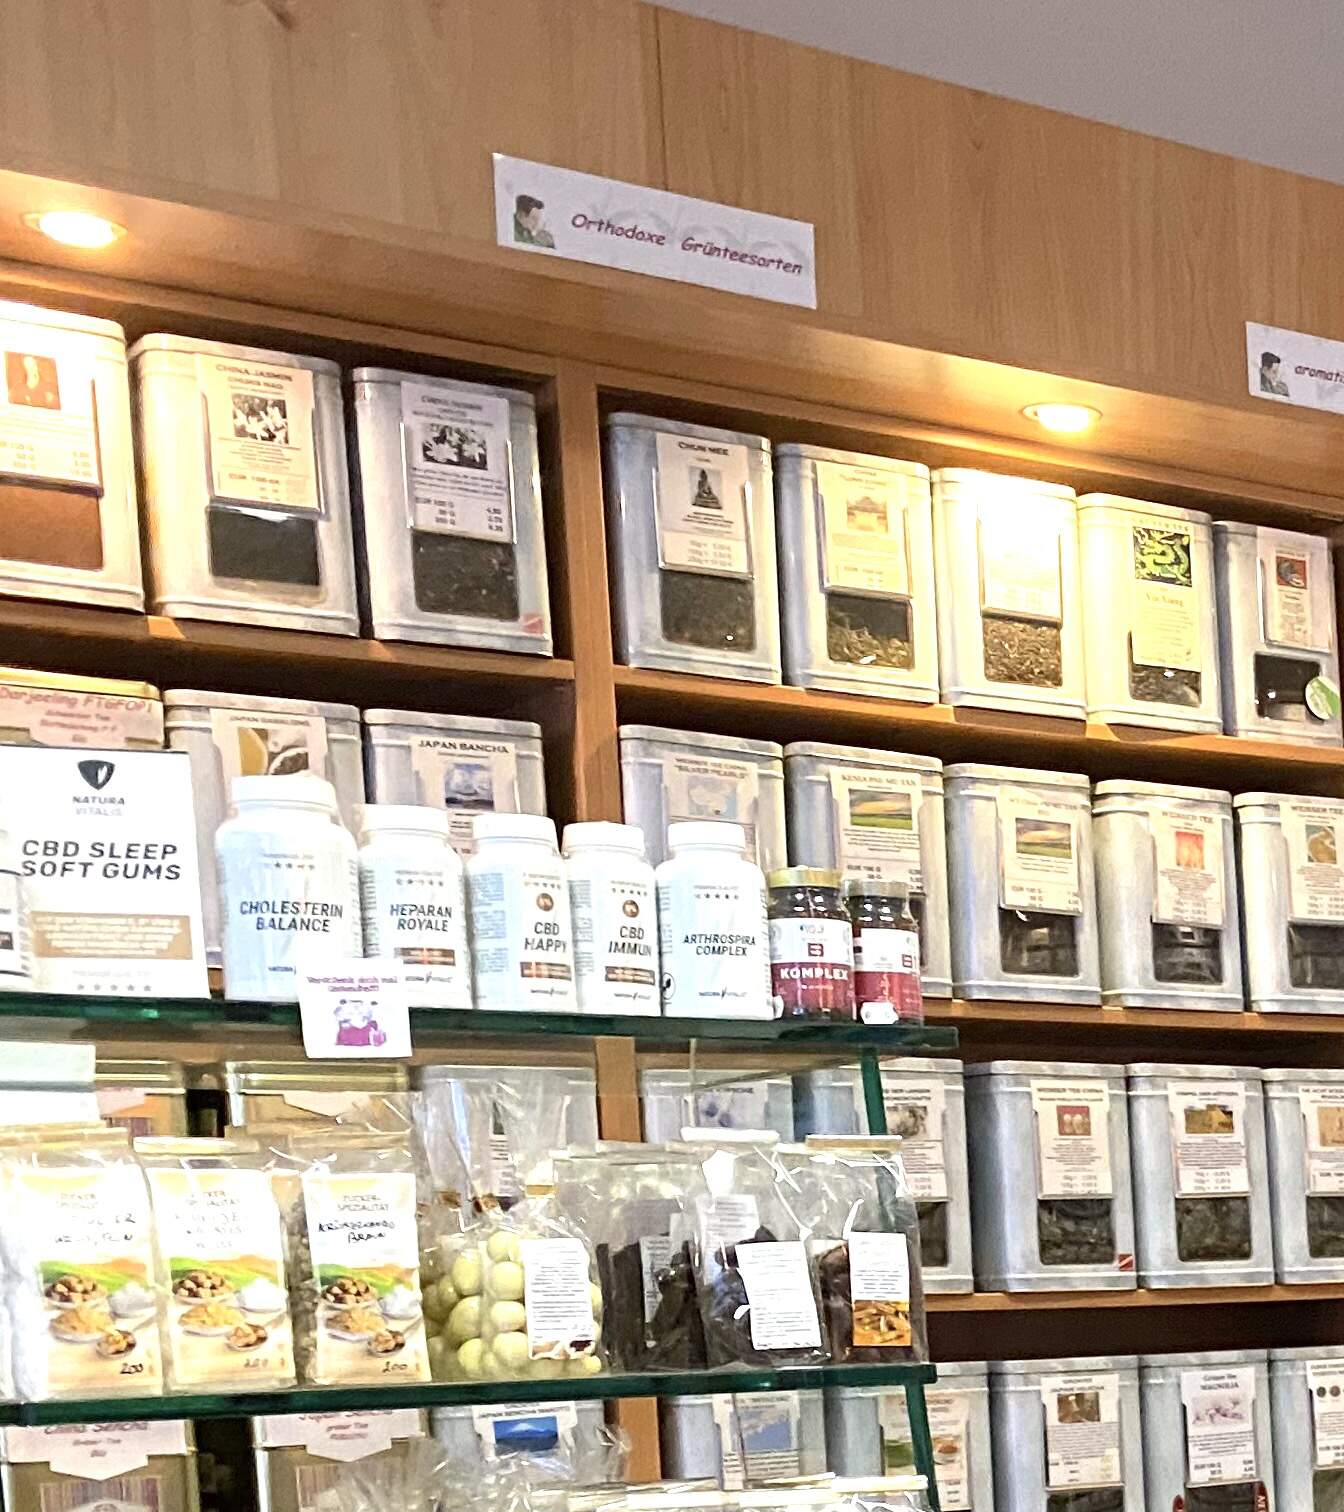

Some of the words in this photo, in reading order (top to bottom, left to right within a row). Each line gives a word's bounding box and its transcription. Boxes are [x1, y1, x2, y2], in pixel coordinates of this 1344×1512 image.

[571, 213, 666, 246] Orthodoxe
[681, 237, 802, 275] Grünteesorten
[419, 739, 457, 750] JAPAN
[72, 795, 126, 807] NATURA
[22, 838, 80, 858] CBD
[88, 840, 178, 862] SLEEP
[20, 860, 98, 879] SOFT
[103, 862, 182, 881] GUMS
[239, 900, 344, 919] CHOLESTERIN
[389, 903, 454, 920] HEPARAN
[256, 916, 331, 933] BALANCE
[396, 917, 450, 933] ROYALE
[533, 921, 560, 936] CBD
[619, 925, 645, 940] CBD
[524, 935, 568, 955] HAPPY
[683, 932, 757, 947] ARTHROSPIRA
[608, 939, 653, 958] IMMUN
[695, 944, 748, 958] COMPLEX
[780, 966, 849, 982] KOMPLEX
